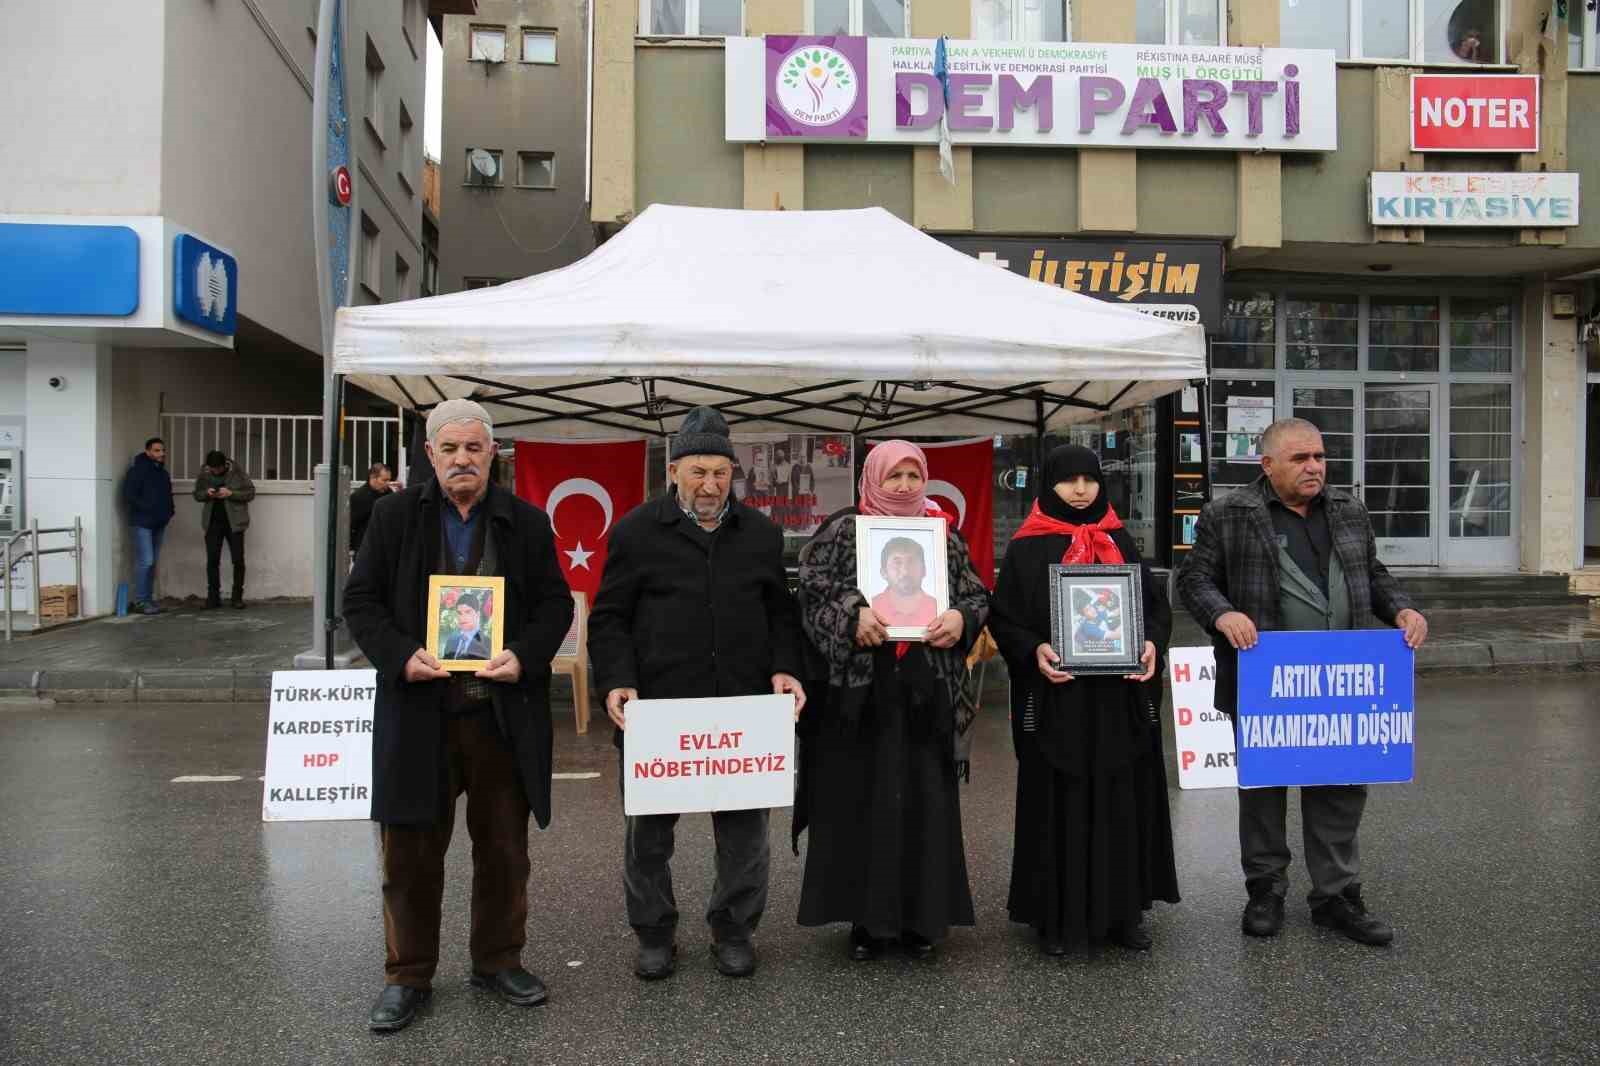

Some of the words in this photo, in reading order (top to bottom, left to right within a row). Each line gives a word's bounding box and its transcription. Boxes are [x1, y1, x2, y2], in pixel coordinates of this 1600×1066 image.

[892, 60, 952, 71] HALKLAN
[994, 62, 1007, 72] VE
[1009, 62, 1066, 73] DEMOKRASİ
[1069, 63, 1108, 74] PARTİSİ
[1136, 66, 1171, 80] MUŞ
[1195, 65, 1263, 80] ÖRGÜTÜ
[895, 72, 1053, 132] DEM
[1078, 63, 1300, 137] PARTİ
[1420, 97, 1530, 128] NOTER
[1376, 193, 1571, 218] KIRTASİYE
[1028, 249, 1200, 301] İLETİŞİM
[1271, 664, 1322, 698] ARTIK
[1326, 664, 1375, 697] YETER
[273, 685, 375, 702] TÜRK-KÜRT
[273, 717, 373, 737] KARDEŞTİR
[1240, 712, 1352, 748] YAKAMIZDAN
[1357, 704, 1413, 754] DÜŞÜN
[679, 732, 743, 751] EVLAT
[303, 753, 339, 768] HDP
[634, 753, 786, 779] NÖBETİNDEYİZ
[270, 784, 368, 803] KALLEŞTİR
